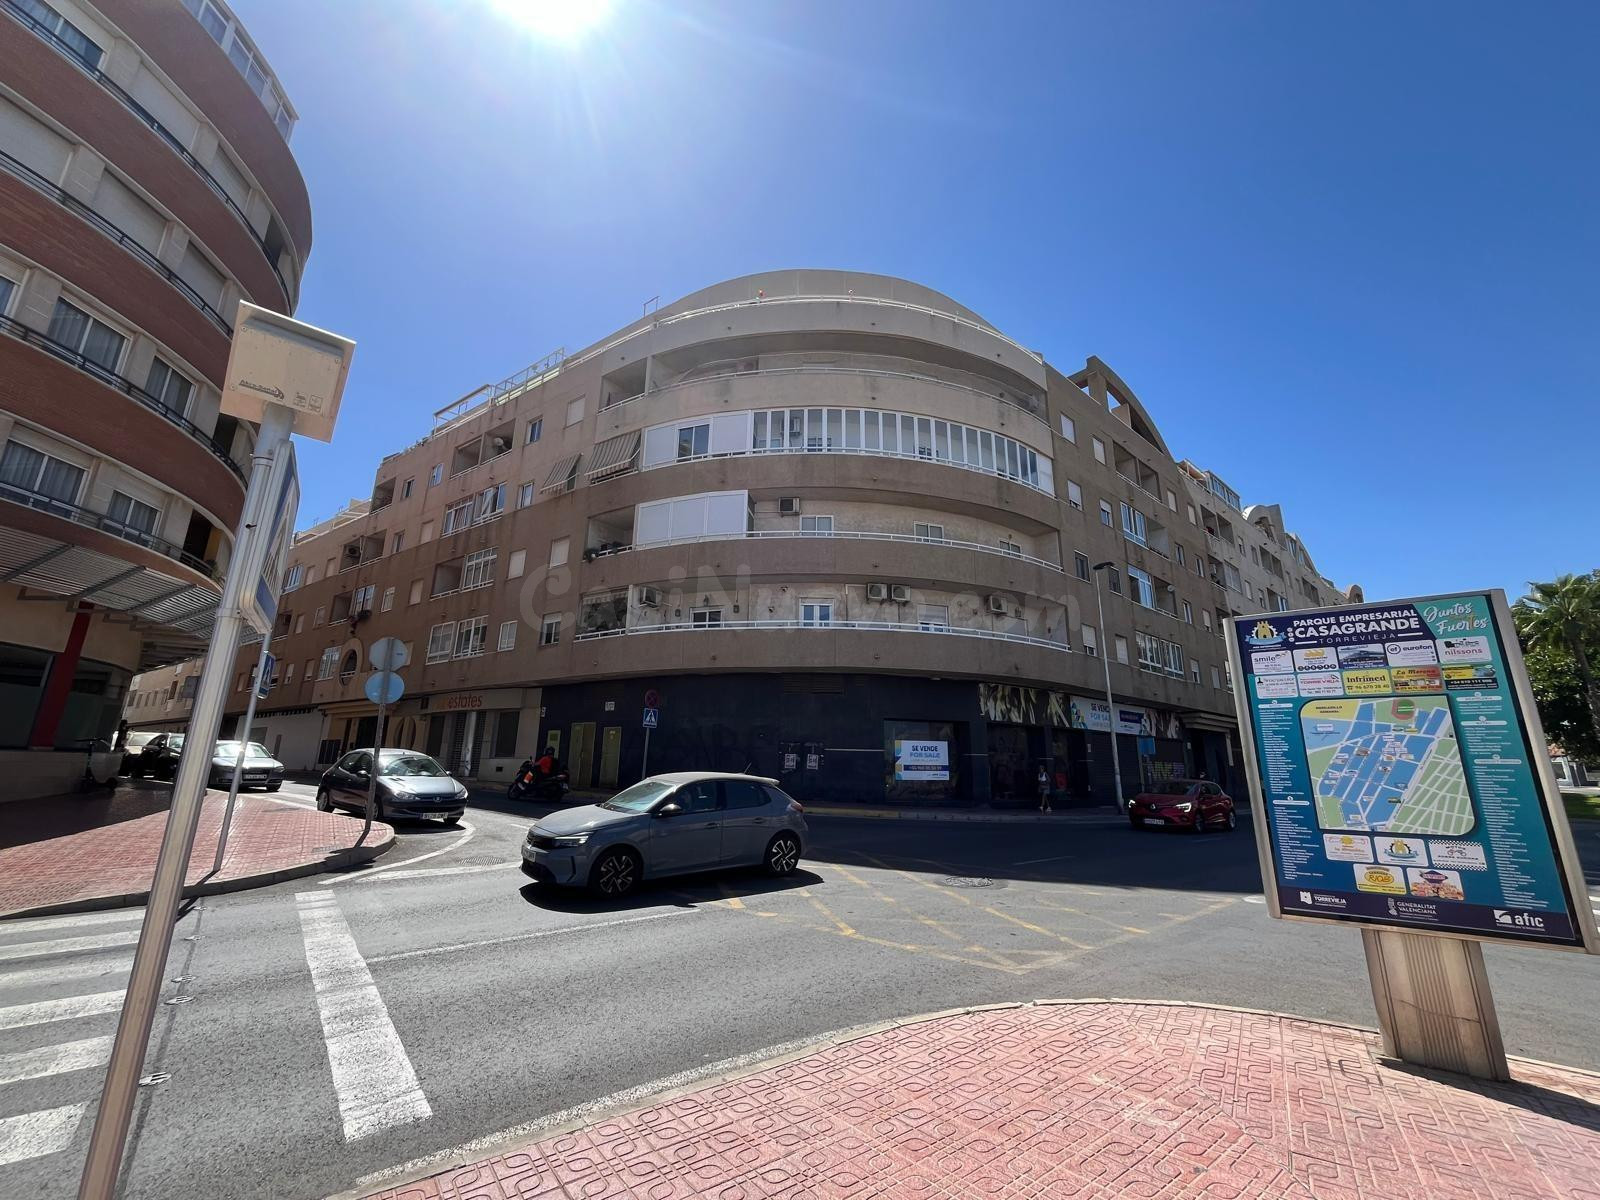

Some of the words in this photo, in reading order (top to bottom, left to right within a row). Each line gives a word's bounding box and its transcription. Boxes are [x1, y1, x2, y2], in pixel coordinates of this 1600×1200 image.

[1423, 602, 1473, 623] Juntos
[1293, 616, 1336, 627] PARQUE
[1339, 609, 1418, 624] EMPRESARIAL
[1294, 617, 1420, 638] CASAGRANDE
[1319, 633, 1396, 644] TORREVIEJA
[1402, 644, 1433, 652] eurofon
[1444, 648, 1483, 656] nilssons
[1253, 655, 1276, 663] smile
[1397, 901, 1437, 910] GENERALITAT
[1398, 906, 1438, 915] VALENCIANA
[1514, 912, 1545, 928] afic
